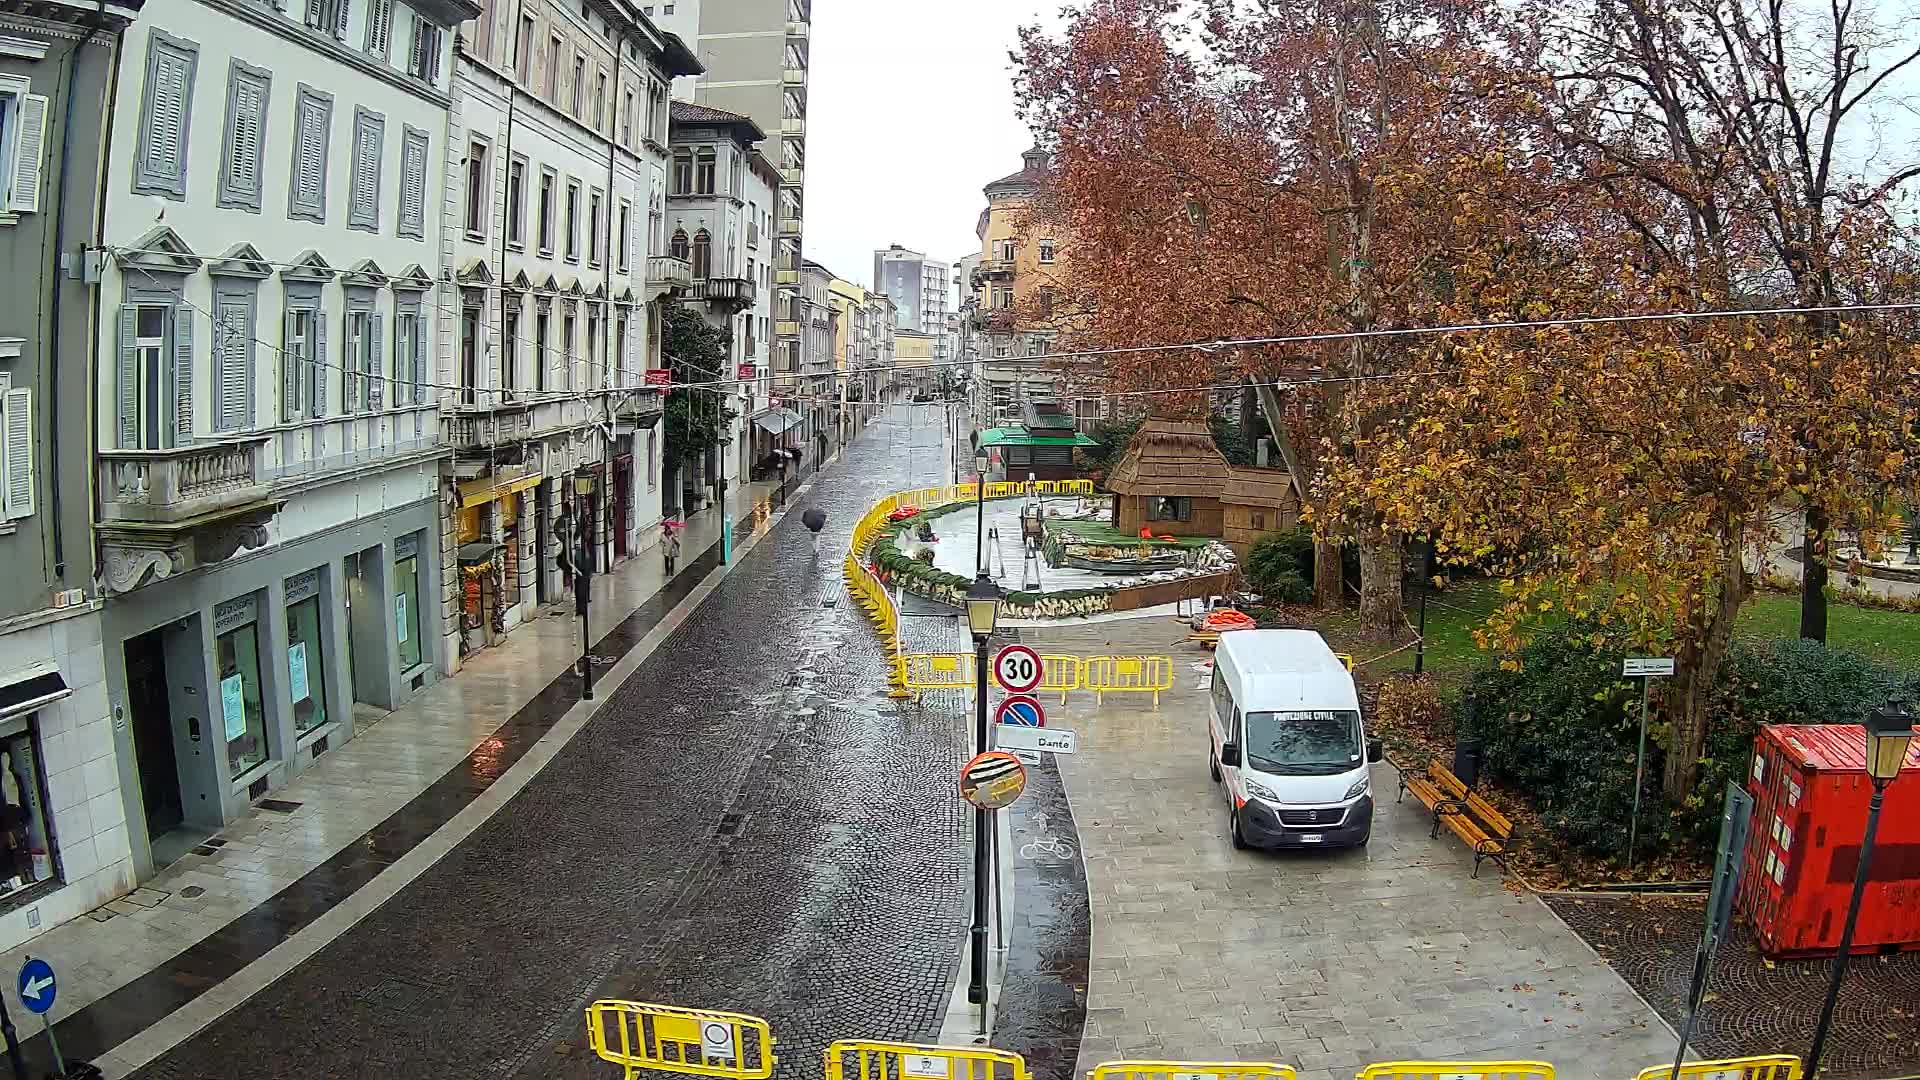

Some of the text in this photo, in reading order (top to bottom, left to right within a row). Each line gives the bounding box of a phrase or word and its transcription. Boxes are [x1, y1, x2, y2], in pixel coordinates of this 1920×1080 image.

[1005, 658, 1033, 680] 30
[1313, 711, 1334, 721] CIVILE
[1038, 738, 1070, 749] Dante
